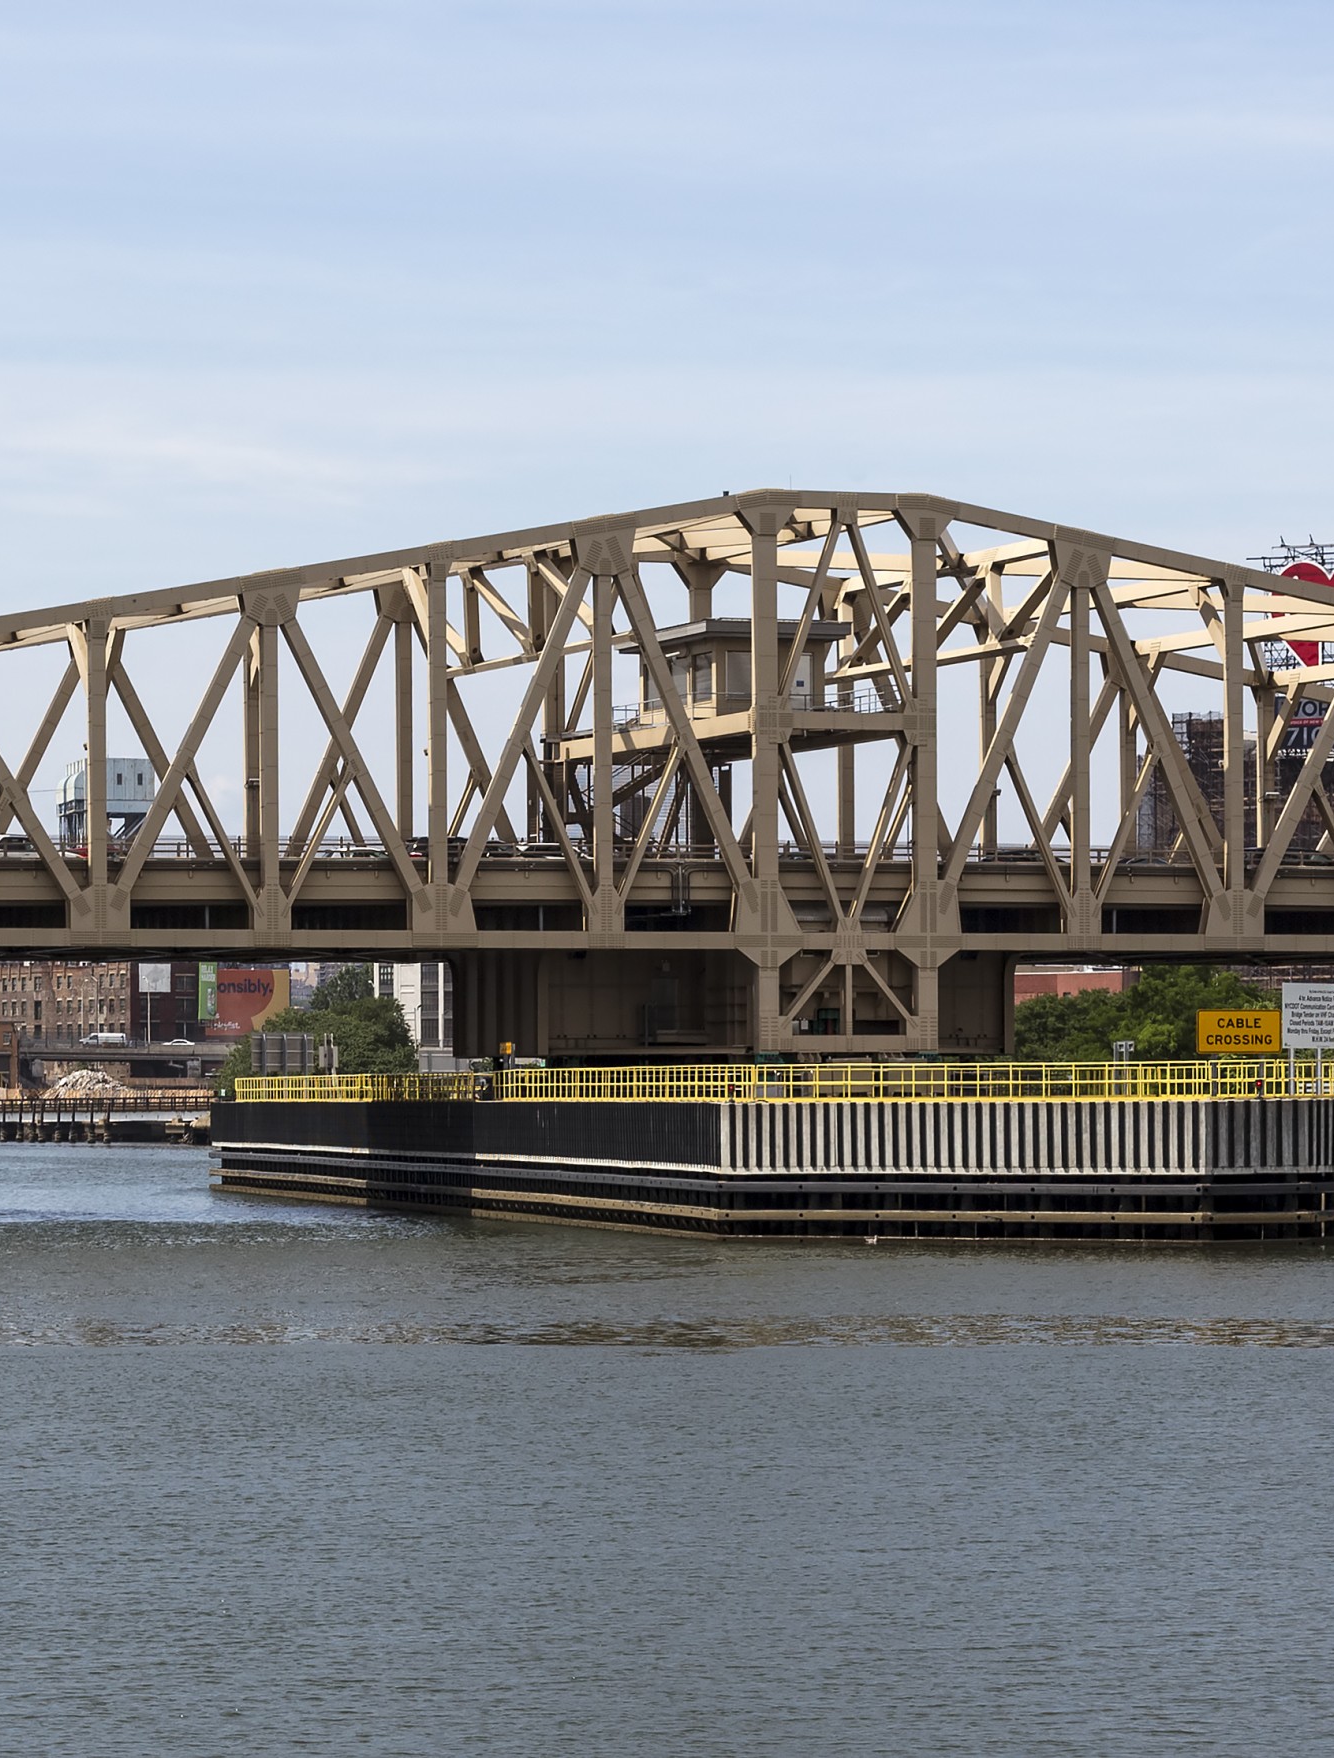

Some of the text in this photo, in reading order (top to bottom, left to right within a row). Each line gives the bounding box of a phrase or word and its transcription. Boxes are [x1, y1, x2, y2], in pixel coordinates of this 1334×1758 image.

[218, 979, 273, 996] onsibly.
[1217, 1018, 1262, 1029] CABLE
[1206, 1034, 1273, 1046] CROSSING
